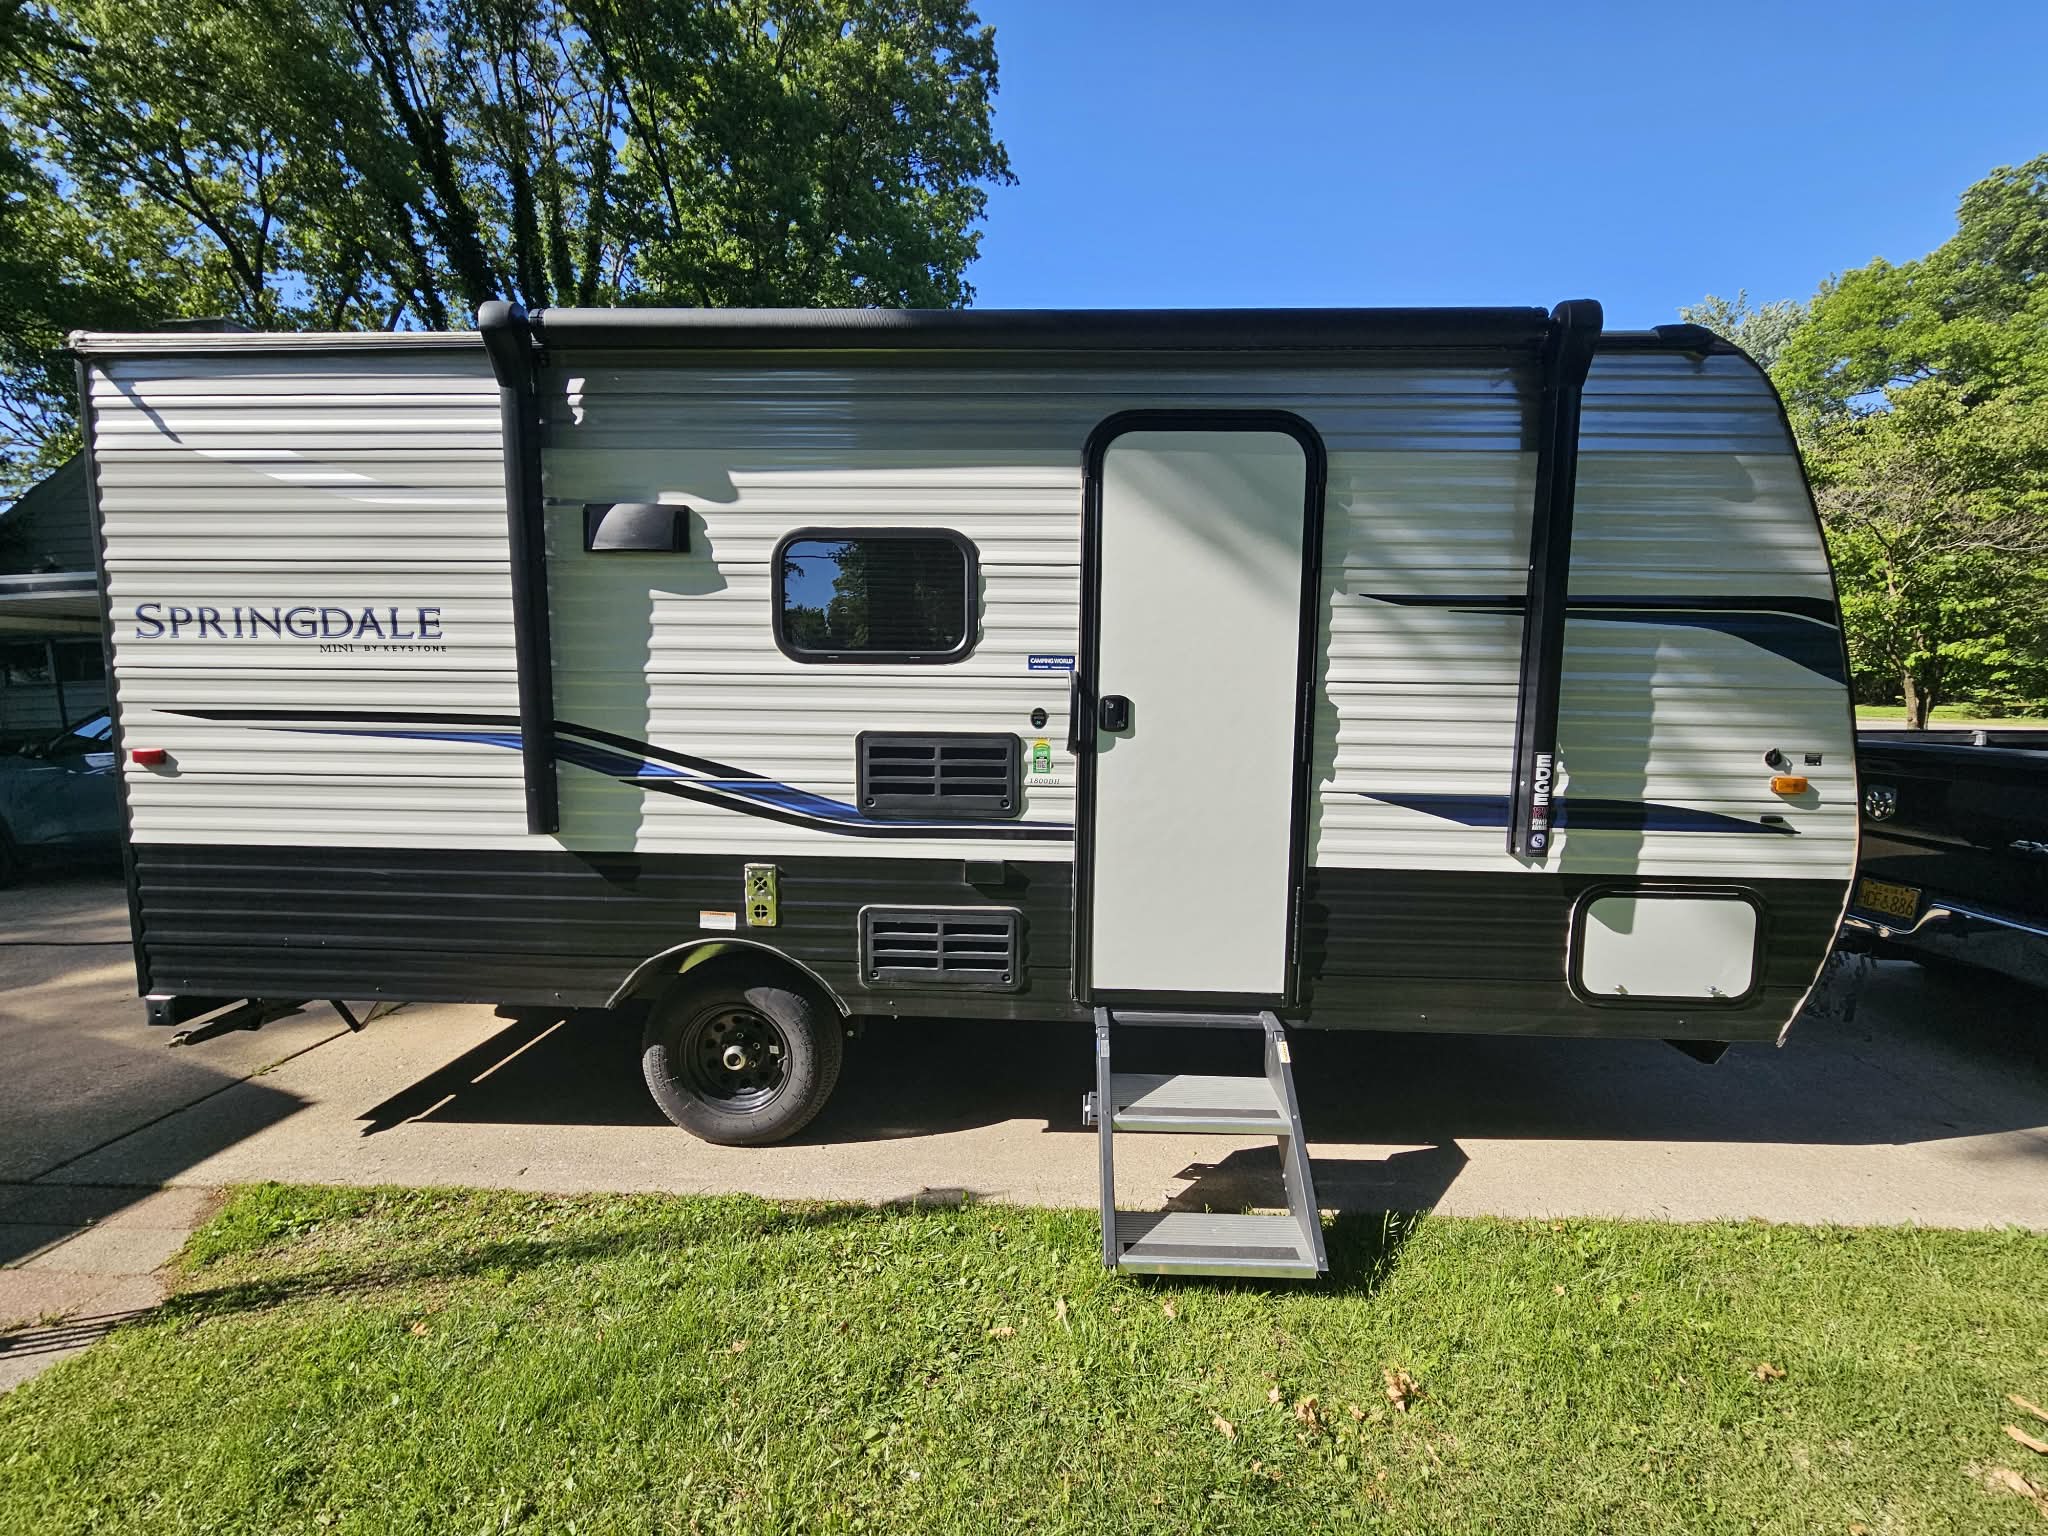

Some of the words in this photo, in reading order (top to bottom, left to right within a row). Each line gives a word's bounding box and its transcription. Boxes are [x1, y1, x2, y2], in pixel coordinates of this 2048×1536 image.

[135, 602, 443, 640] SPRINGDALE
[320, 644, 354, 653] MINI
[384, 645, 447, 653] KEYSTONE
[1533, 754, 1553, 806] EDGE
